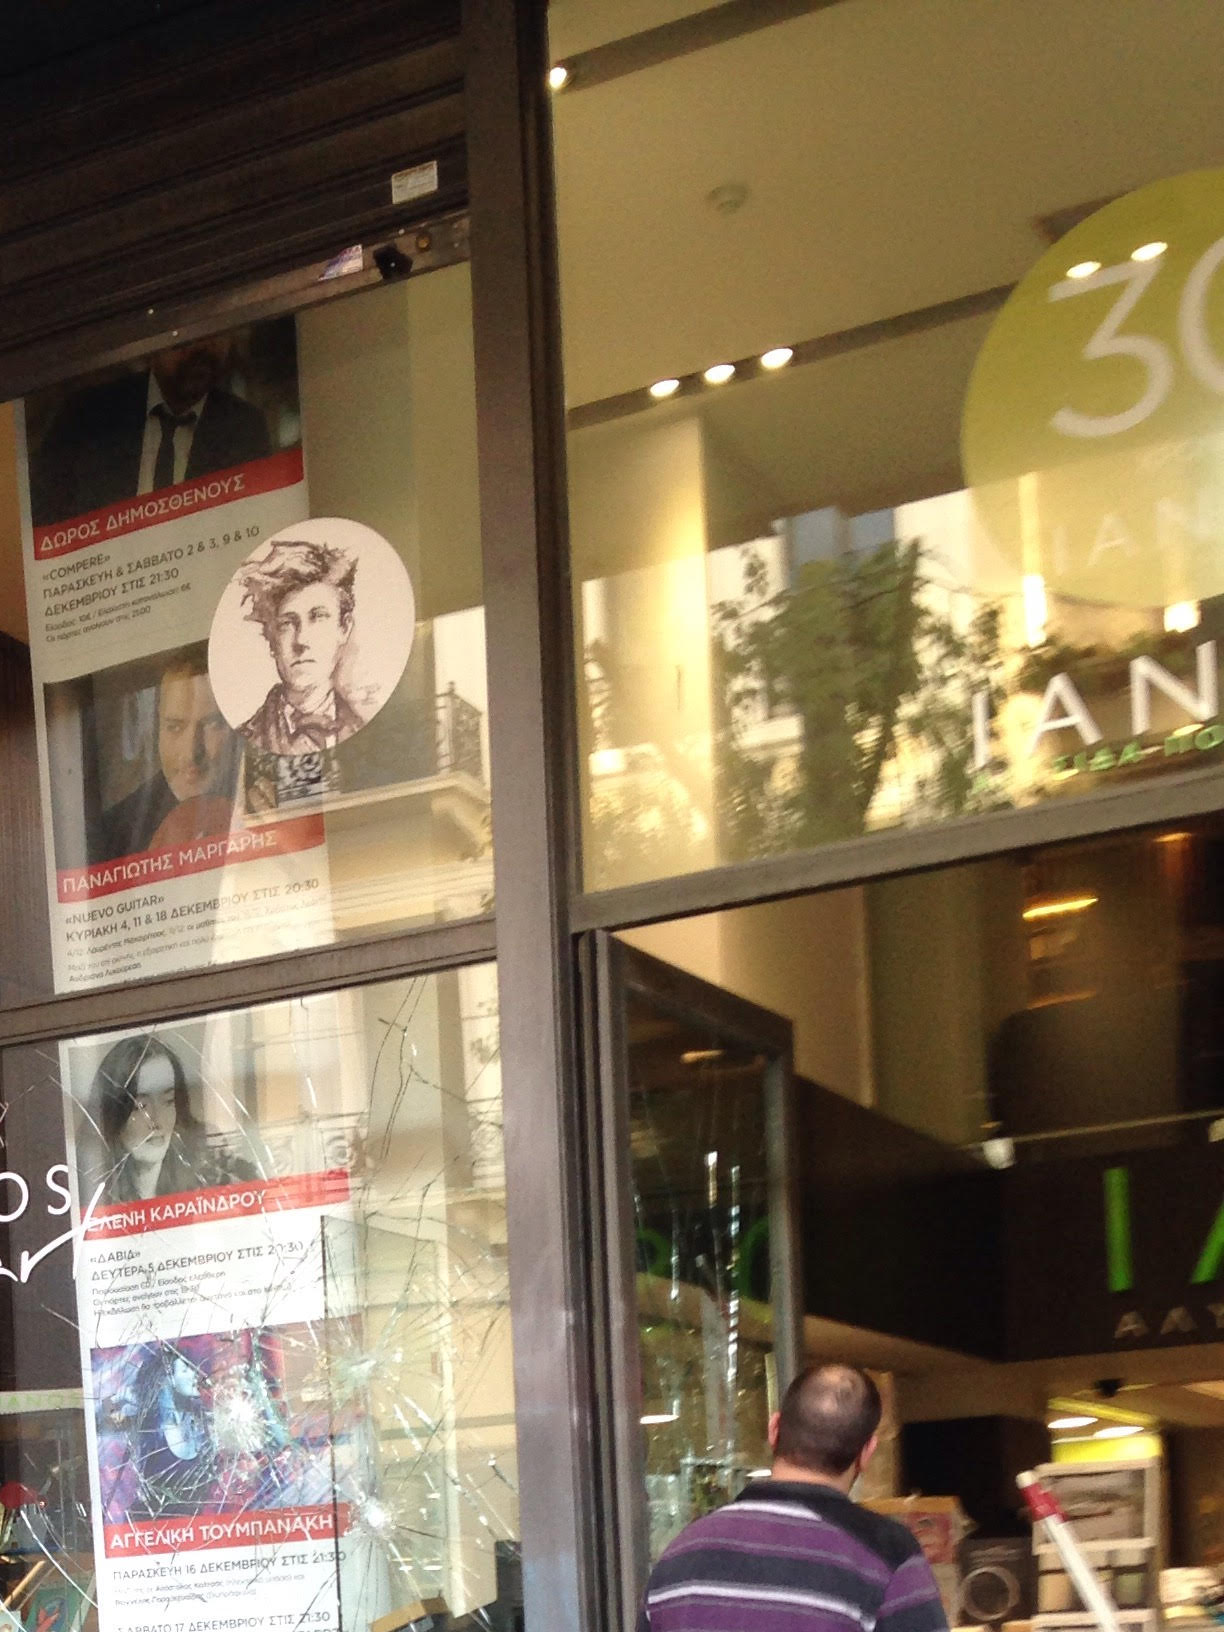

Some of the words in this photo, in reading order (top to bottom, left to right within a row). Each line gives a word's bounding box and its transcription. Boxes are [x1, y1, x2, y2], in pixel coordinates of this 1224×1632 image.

[40, 519, 101, 551] ΔΩΡΟΣ
[106, 474, 246, 530] ΔΗΜΟΣΘΕΝΟΥΣ
[43, 570, 113, 599] ΠΑΡΑΣΚΕΥΗ
[116, 566, 124, 577] &
[127, 549, 184, 574] ΣΑΒΒΑΤΟ
[187, 543, 195, 555] 2
[196, 541, 205, 552] &
[233, 531, 242, 542] &
[246, 525, 260, 538] 10
[44, 586, 118, 617] ΔΕΚΕΜΒΡΙΟΥ
[121, 577, 146, 594] ΣΤΙΣ
[149, 567, 179, 585] 21:30
[63, 853, 174, 893] ΠΑΝΑΓΙΩΤΗΣ
[179, 830, 277, 867] ΜΑΡΓΑΡΗΣ
[66, 924, 118, 942] ΚΥΡΙΑΚΗ
[133, 916, 141, 928] 11
[145, 914, 152, 925] &
[156, 911, 167, 922] 18
[171, 892, 249, 918] ΔΕΚΕΜΒΡΙΟΥ
[253, 886, 280, 900] ΣΤΙΣ
[285, 878, 320, 895] 20:30
[150, 1190, 267, 1221] ΚΑΡΑΪΝΔΡΟΥ
[92, 1265, 148, 1281] ΔΕΥΤΕΡΑ
[157, 1252, 234, 1272] ΔΕΚΕΜΒΡΙΟΥ
[237, 1246, 264, 1260] ΣΤΙΣ
[110, 1529, 194, 1549] ΑΓΓΕΛΙΚΗ
[200, 1514, 333, 1541] ΤΟΥΜΠΑΝΑΚΗ
[113, 1565, 182, 1581] ΠΑΡΑΣΚΕΥΗ
[186, 1565, 197, 1575] 16
[200, 1557, 277, 1573] ΔΕΚΕΜΒΡΙΟΥ
[281, 1554, 309, 1566] ΣΤΙΣ
[176, 1622, 185, 1632] 17
[188, 1616, 264, 1632] ΔΕΚΕΜΒΡΙΟΥ
[269, 1613, 295, 1626] ΣΤΙΣ
[299, 1611, 330, 1624] 21:30
